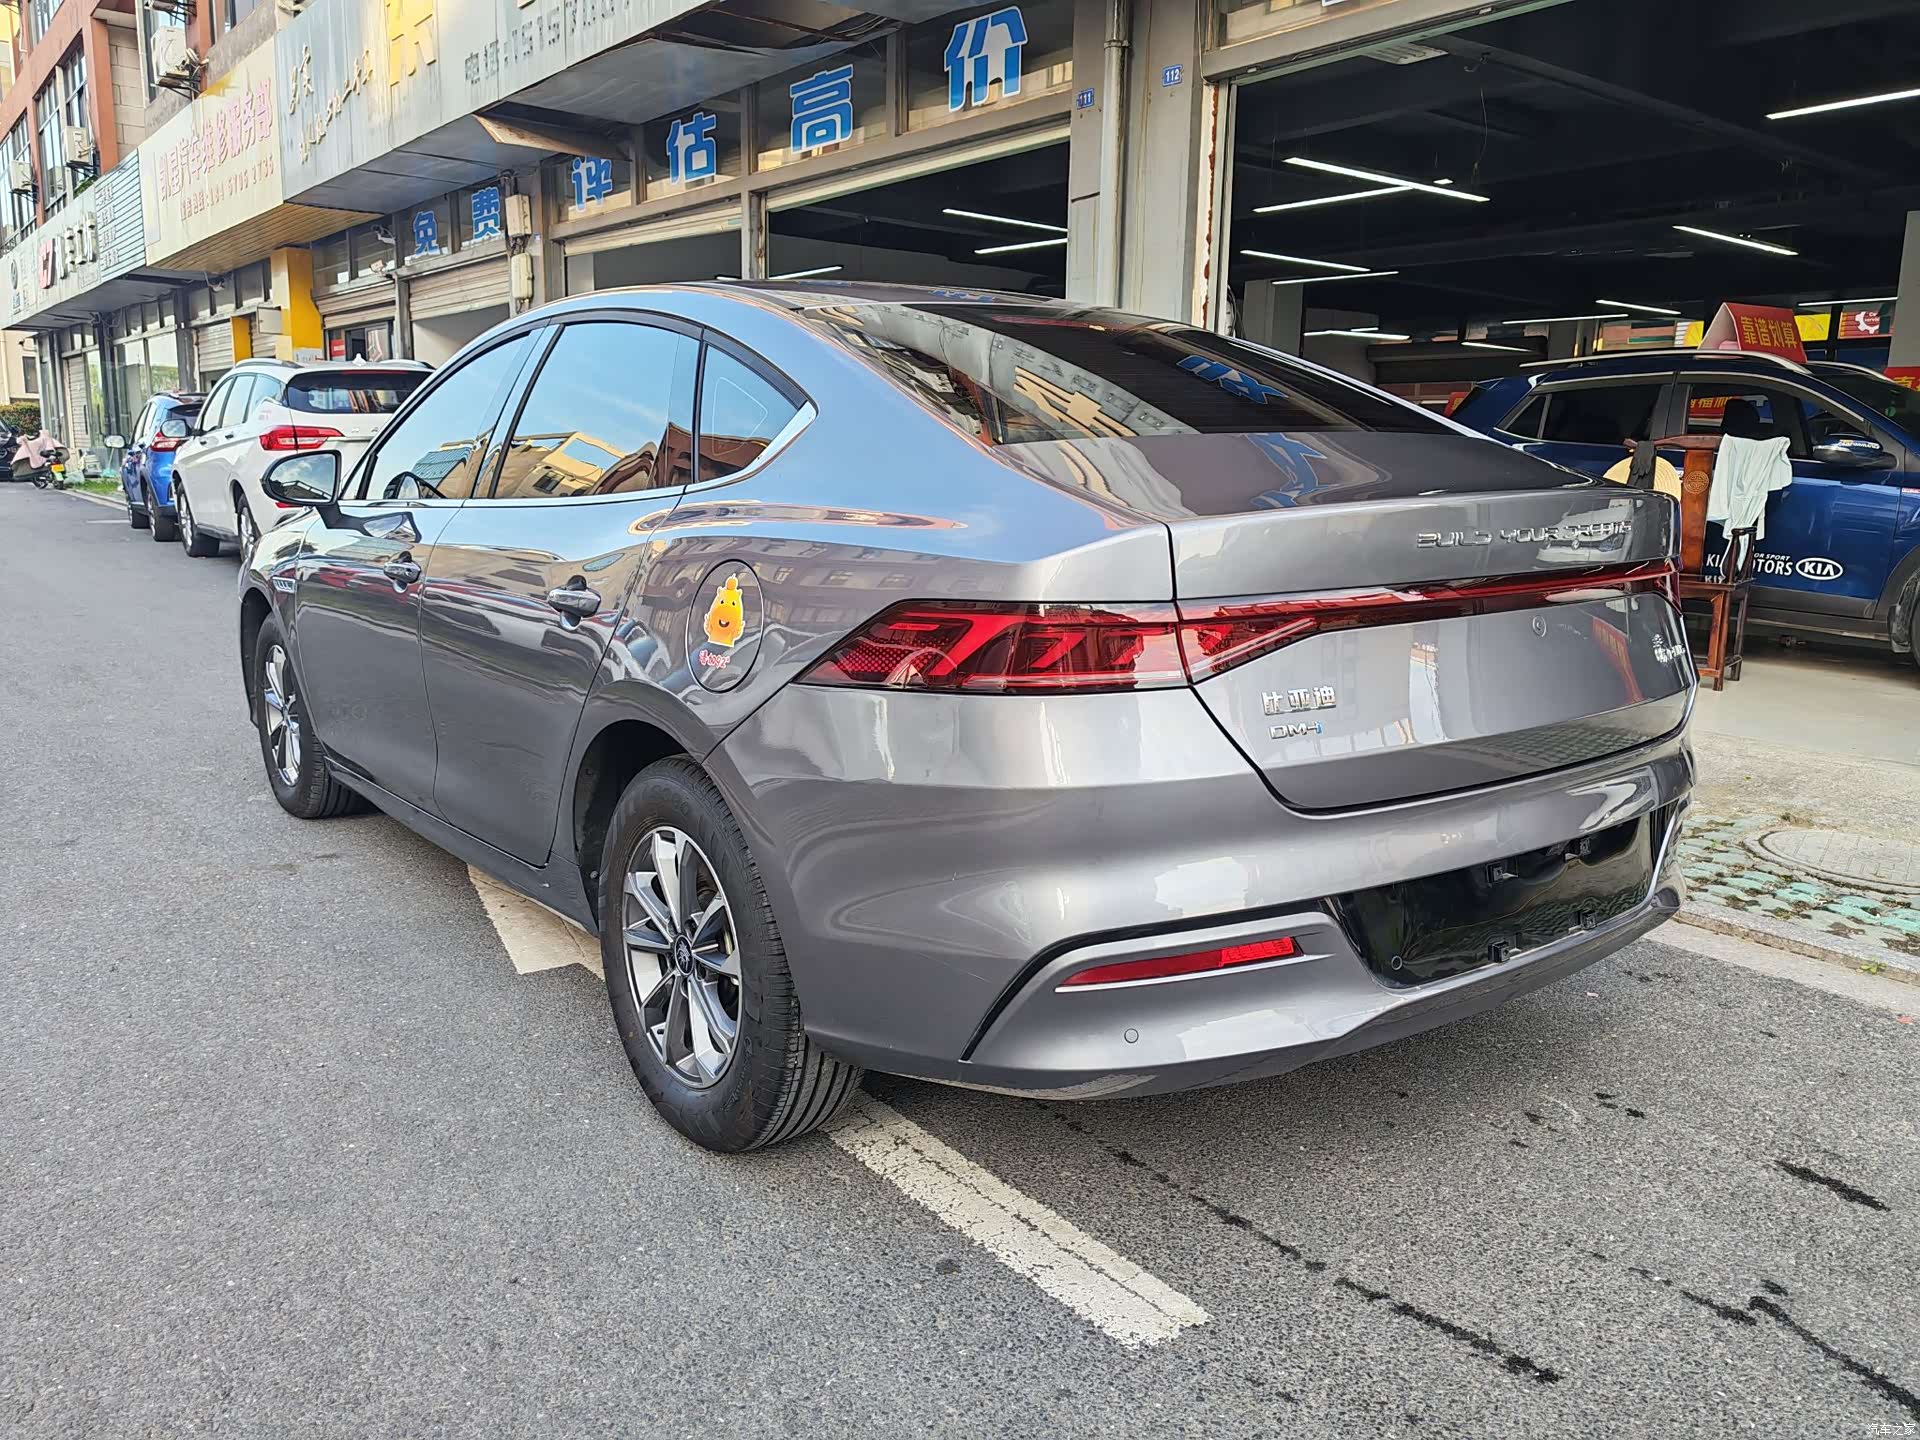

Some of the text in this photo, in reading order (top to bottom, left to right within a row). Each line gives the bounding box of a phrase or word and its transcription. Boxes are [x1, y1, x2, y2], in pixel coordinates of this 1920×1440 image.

[1165, 68, 1181, 83] 112
[1740, 315, 1798, 349] 靠谱划算
[1416, 531, 1493, 549] BUILD
[1500, 527, 1558, 544] YOUR
[1766, 553, 1791, 561] SPORT
[1261, 685, 1337, 715] 比亚迪
